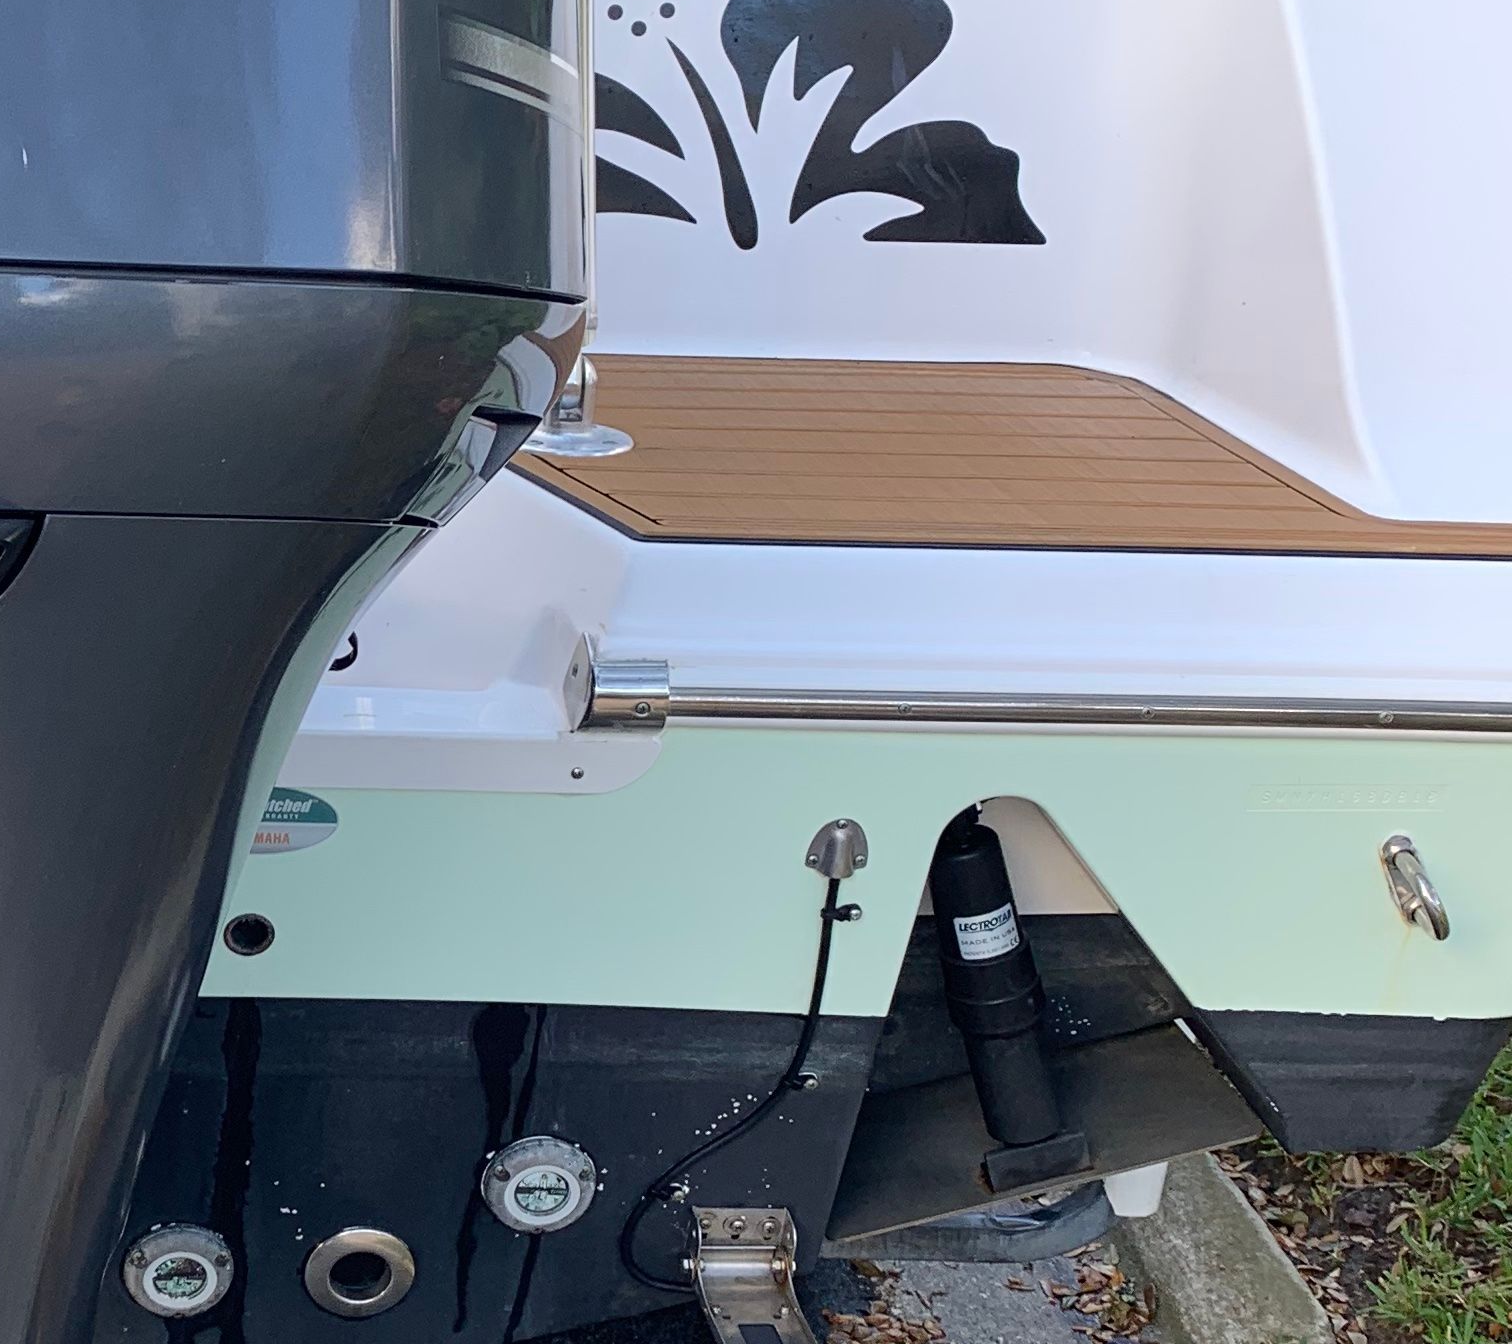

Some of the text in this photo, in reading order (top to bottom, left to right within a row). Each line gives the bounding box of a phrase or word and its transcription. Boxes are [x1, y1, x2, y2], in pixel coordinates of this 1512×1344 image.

[265, 799, 313, 813] tched
[959, 909, 1011, 932] LECTROTAB
[961, 938, 988, 946] MADE
